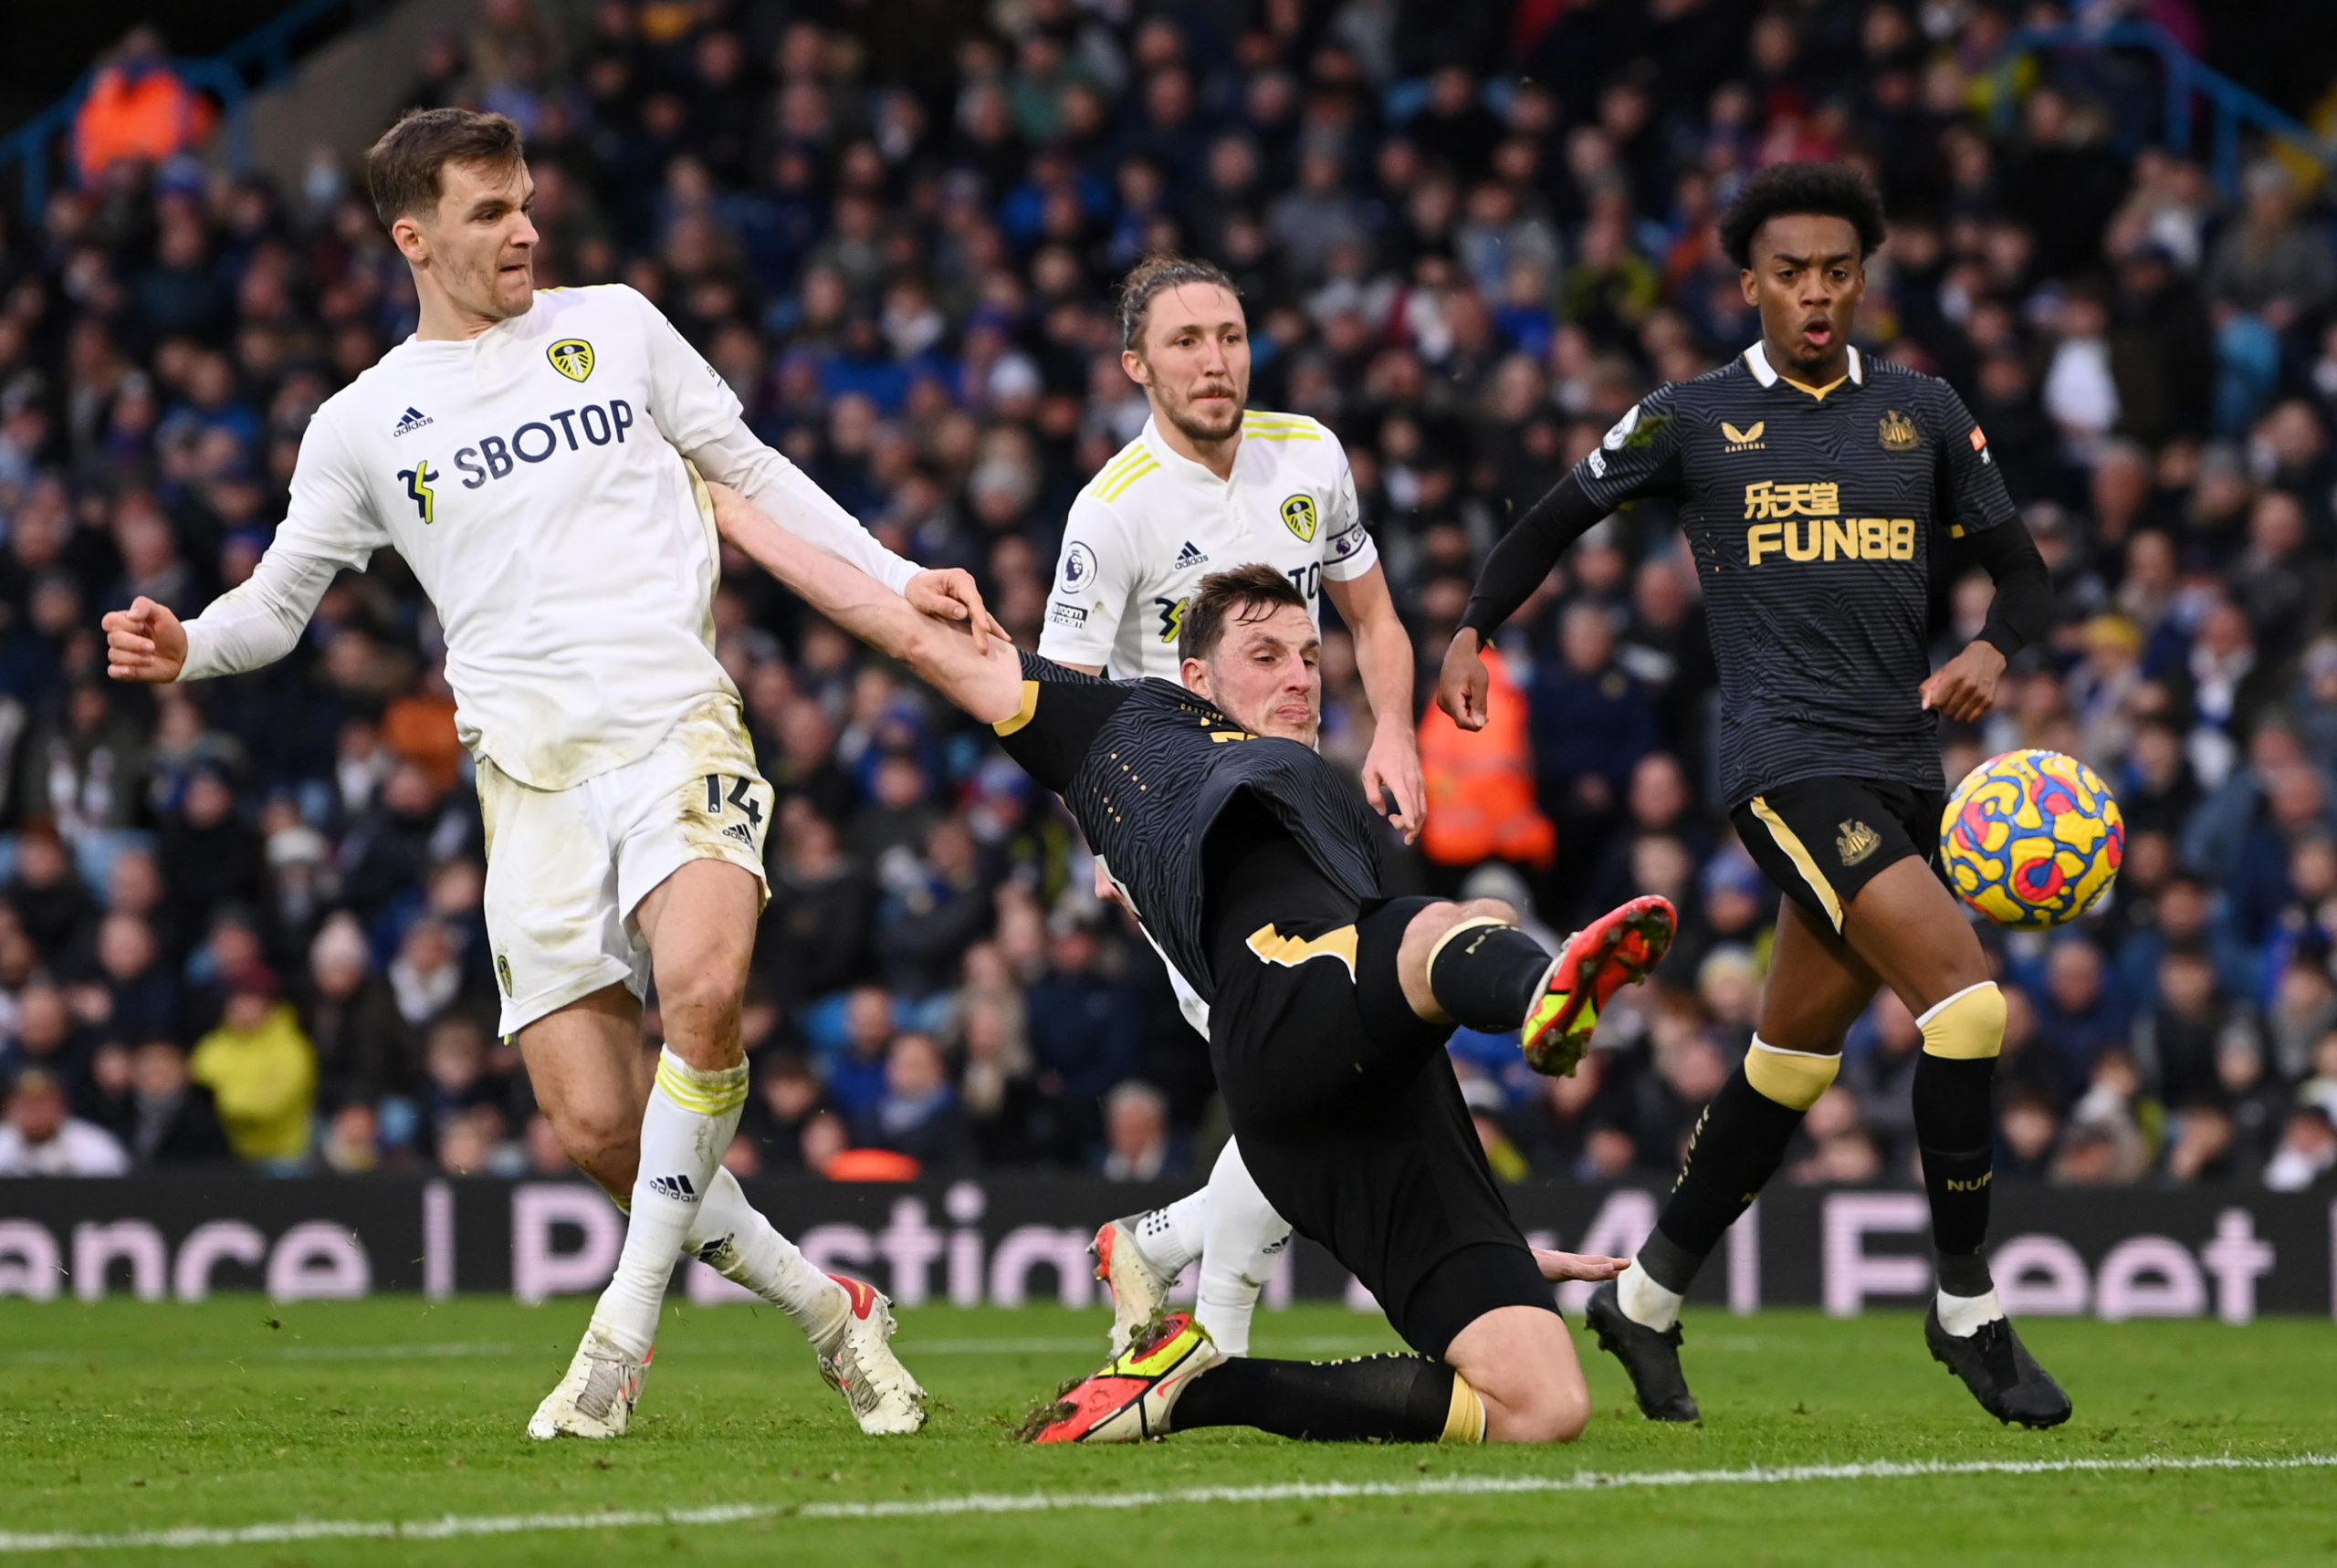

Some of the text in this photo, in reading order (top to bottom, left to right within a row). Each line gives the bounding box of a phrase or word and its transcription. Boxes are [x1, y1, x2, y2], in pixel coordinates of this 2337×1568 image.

[393, 416, 434, 438] adidas
[454, 399, 634, 490] SBOTOP
[1745, 480, 1840, 519] 乐天堂
[1174, 553, 1210, 570] adidas
[1747, 518, 1915, 566] FUN88
[705, 773, 764, 825] 14
[649, 1179, 700, 1203] adidas
[1819, 1190, 2275, 1325] Feet
